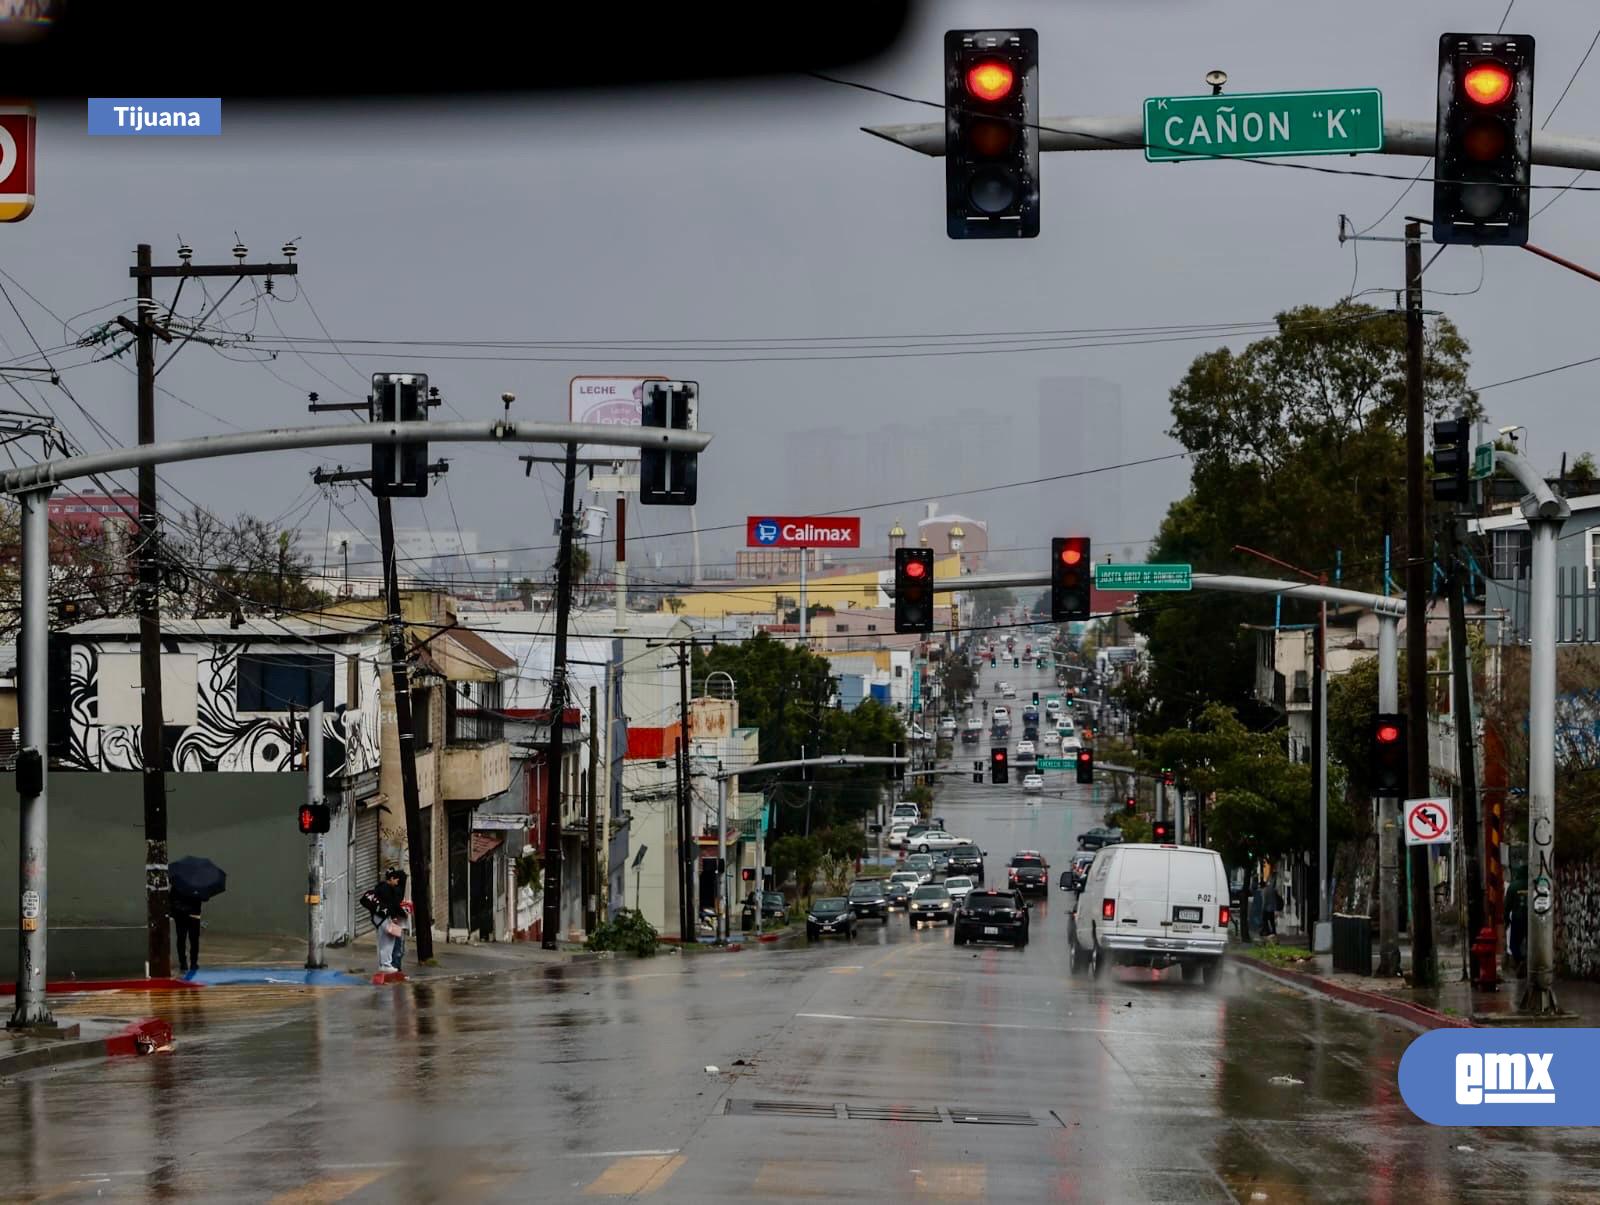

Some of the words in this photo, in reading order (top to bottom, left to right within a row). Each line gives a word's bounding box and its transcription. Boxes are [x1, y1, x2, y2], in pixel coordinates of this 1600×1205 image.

[1157, 99, 1168, 110] K
[1164, 106, 1290, 146] CAÑON
[579, 386, 617, 394] LECHE
[782, 524, 851, 541] Calimax
[1197, 894, 1212, 902] P-02
